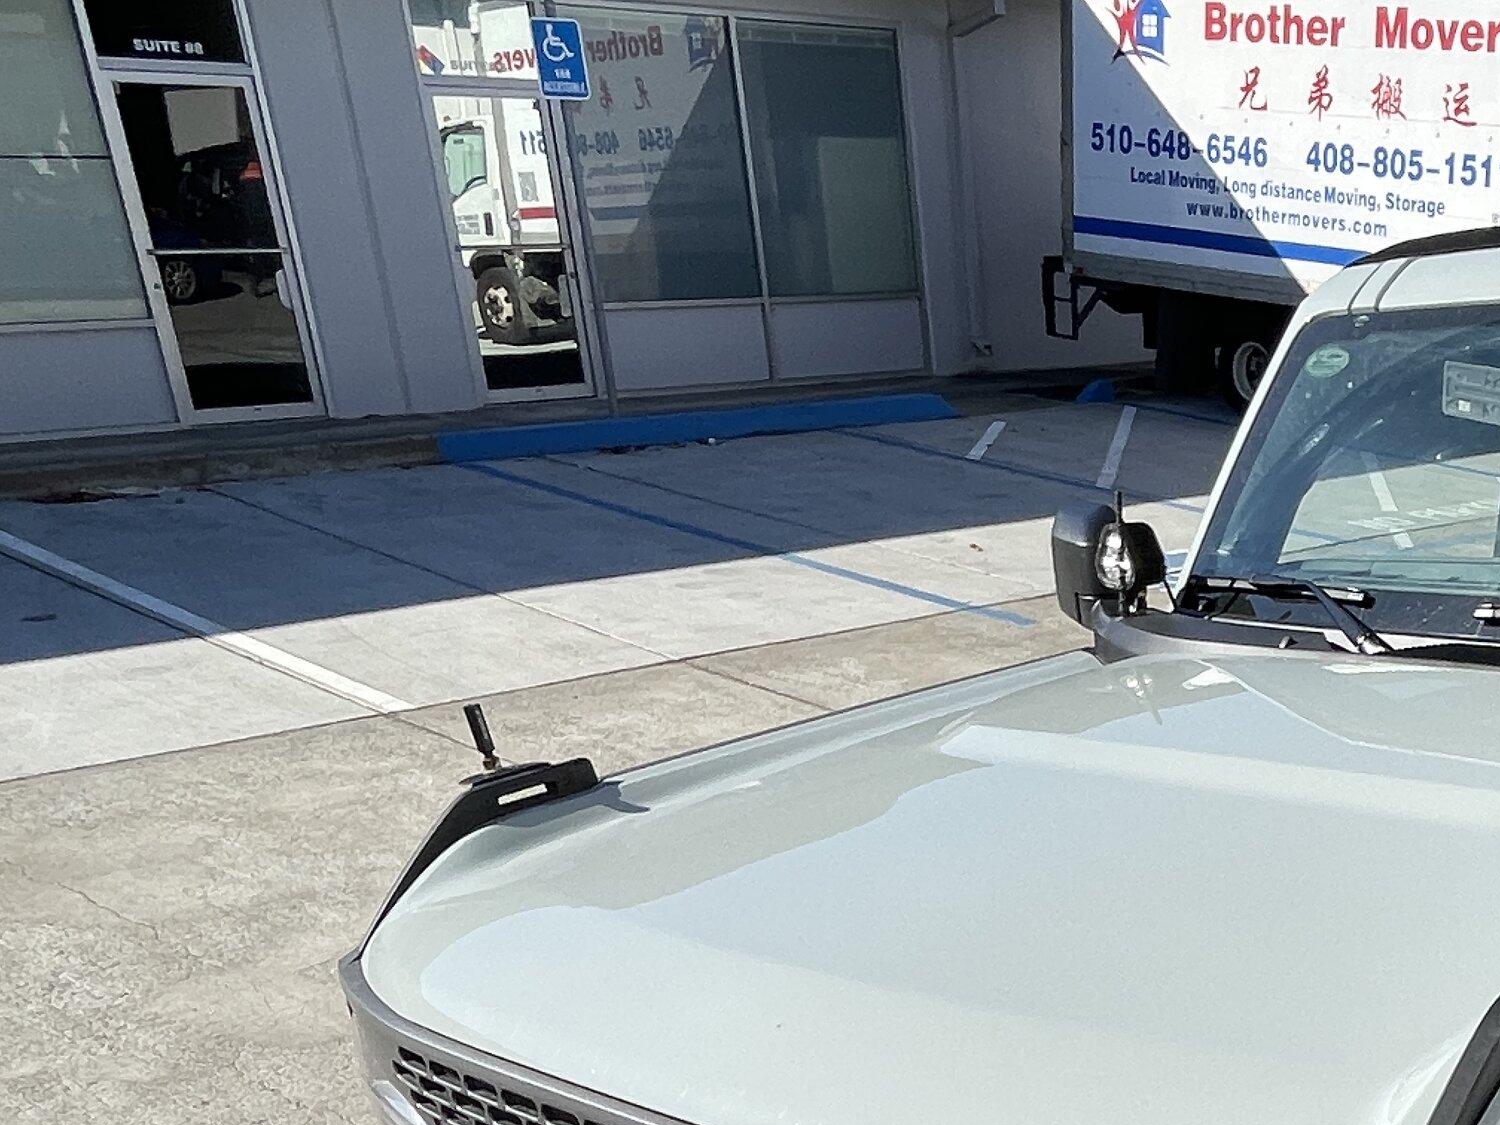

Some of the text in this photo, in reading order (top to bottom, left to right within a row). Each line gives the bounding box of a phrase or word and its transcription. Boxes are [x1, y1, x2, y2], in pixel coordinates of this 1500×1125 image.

[132, 38, 181, 53] SUITE
[1204, 2, 1345, 47] Brother
[1091, 122, 1268, 168] 510-648-6546
[1131, 167, 1445, 218] Local Moving, Long distance Moving, Storage
[1186, 202, 1387, 237] www.brothermovers.com
